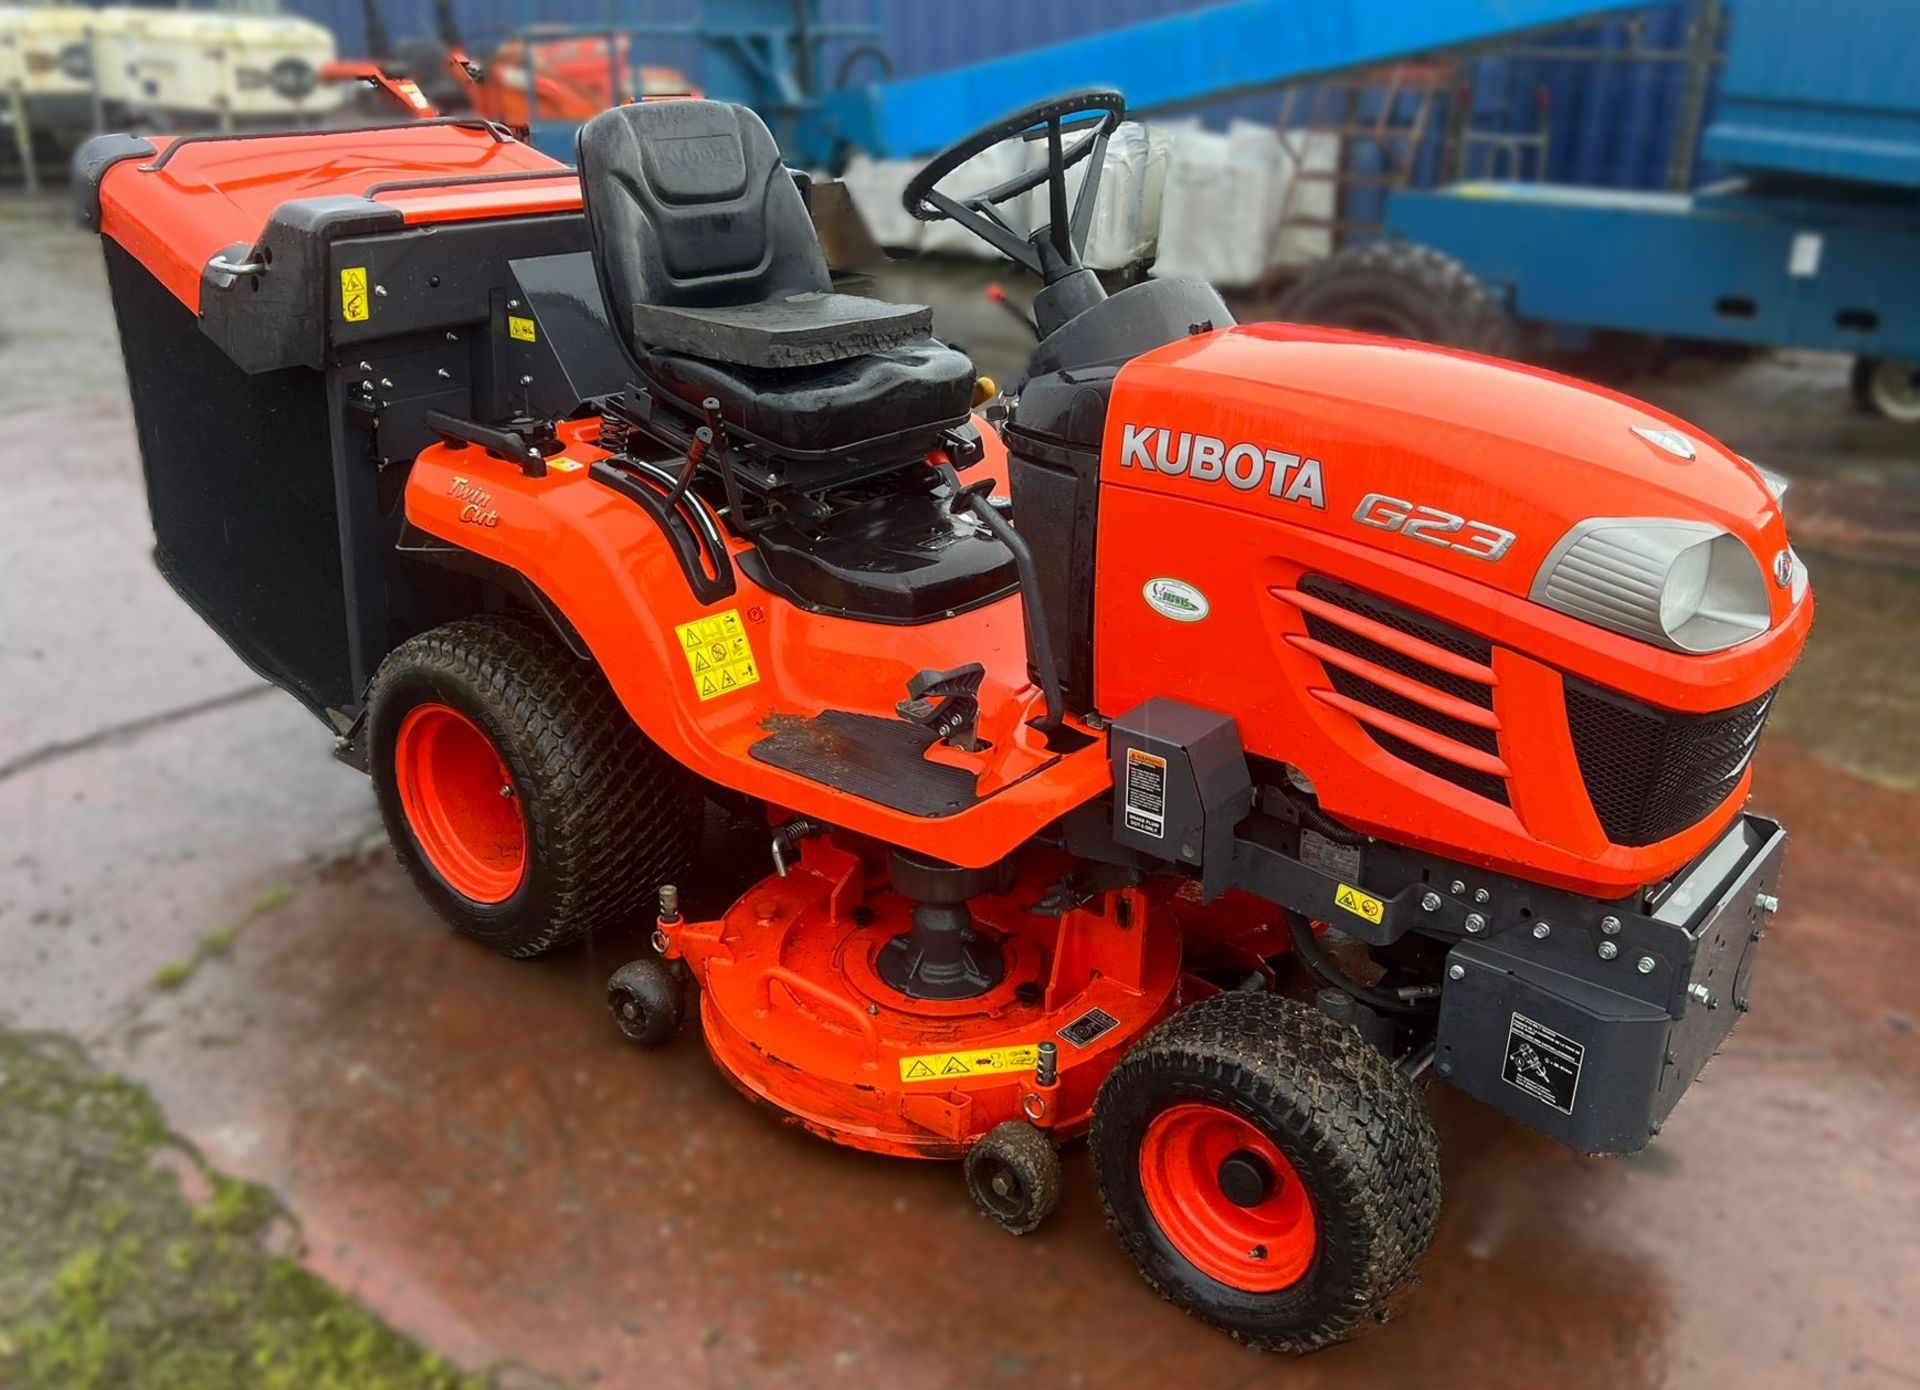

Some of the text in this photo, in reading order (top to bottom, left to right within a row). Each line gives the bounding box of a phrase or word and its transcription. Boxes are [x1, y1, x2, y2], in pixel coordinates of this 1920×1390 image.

[1120, 423, 1327, 509] KUBOTA
[447, 476, 491, 508] Twin
[459, 504, 498, 528] Cut
[1352, 492, 1517, 562] G23
